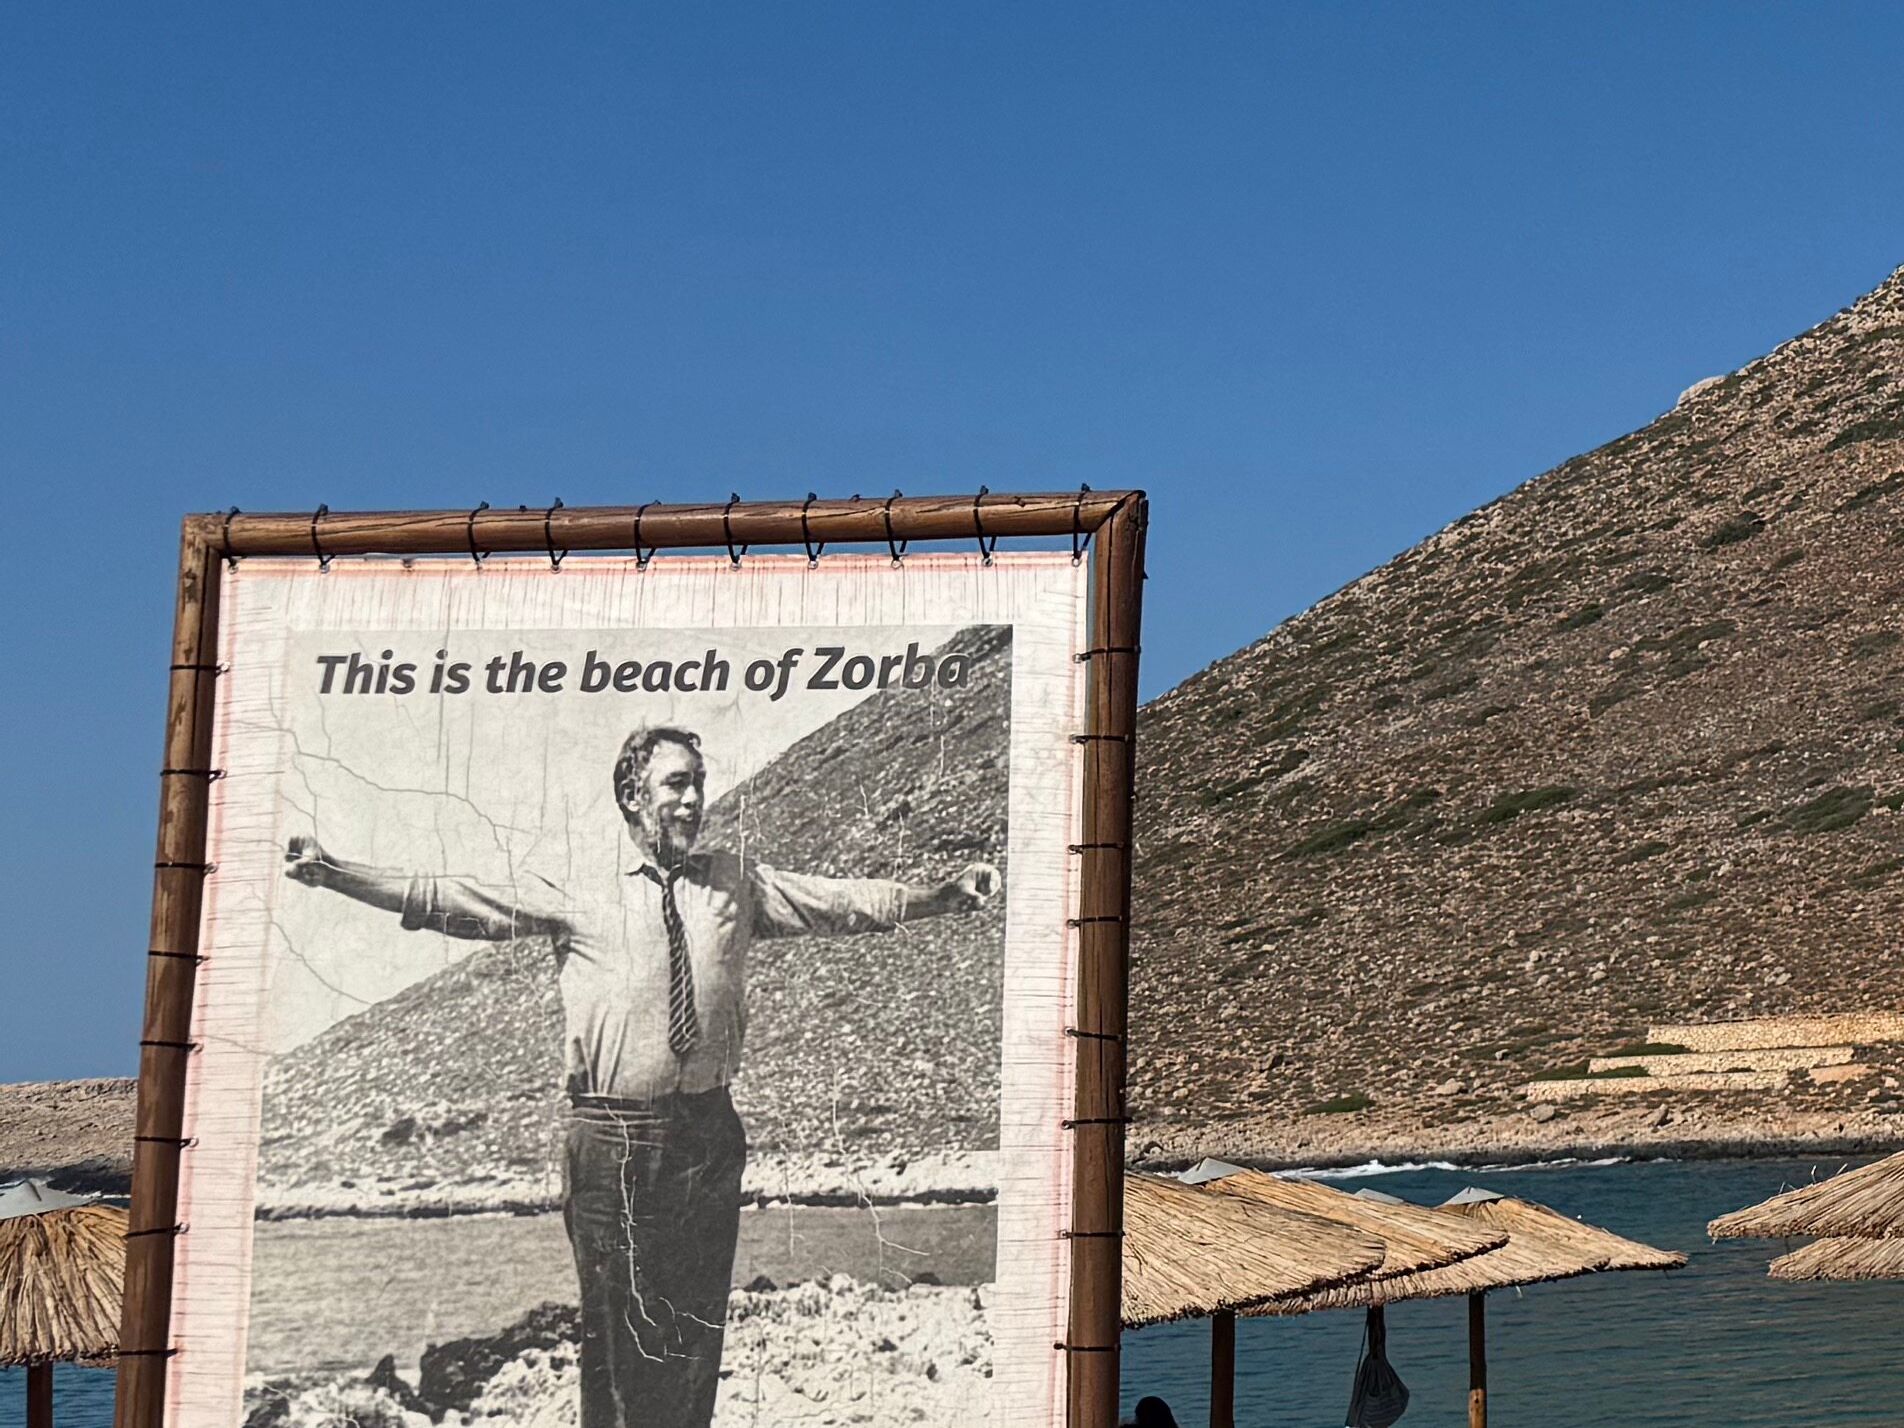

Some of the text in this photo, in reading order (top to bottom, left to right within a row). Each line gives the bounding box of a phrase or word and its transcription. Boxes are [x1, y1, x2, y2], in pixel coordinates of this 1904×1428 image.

[316, 642, 970, 701] This is the beach of Zorba
